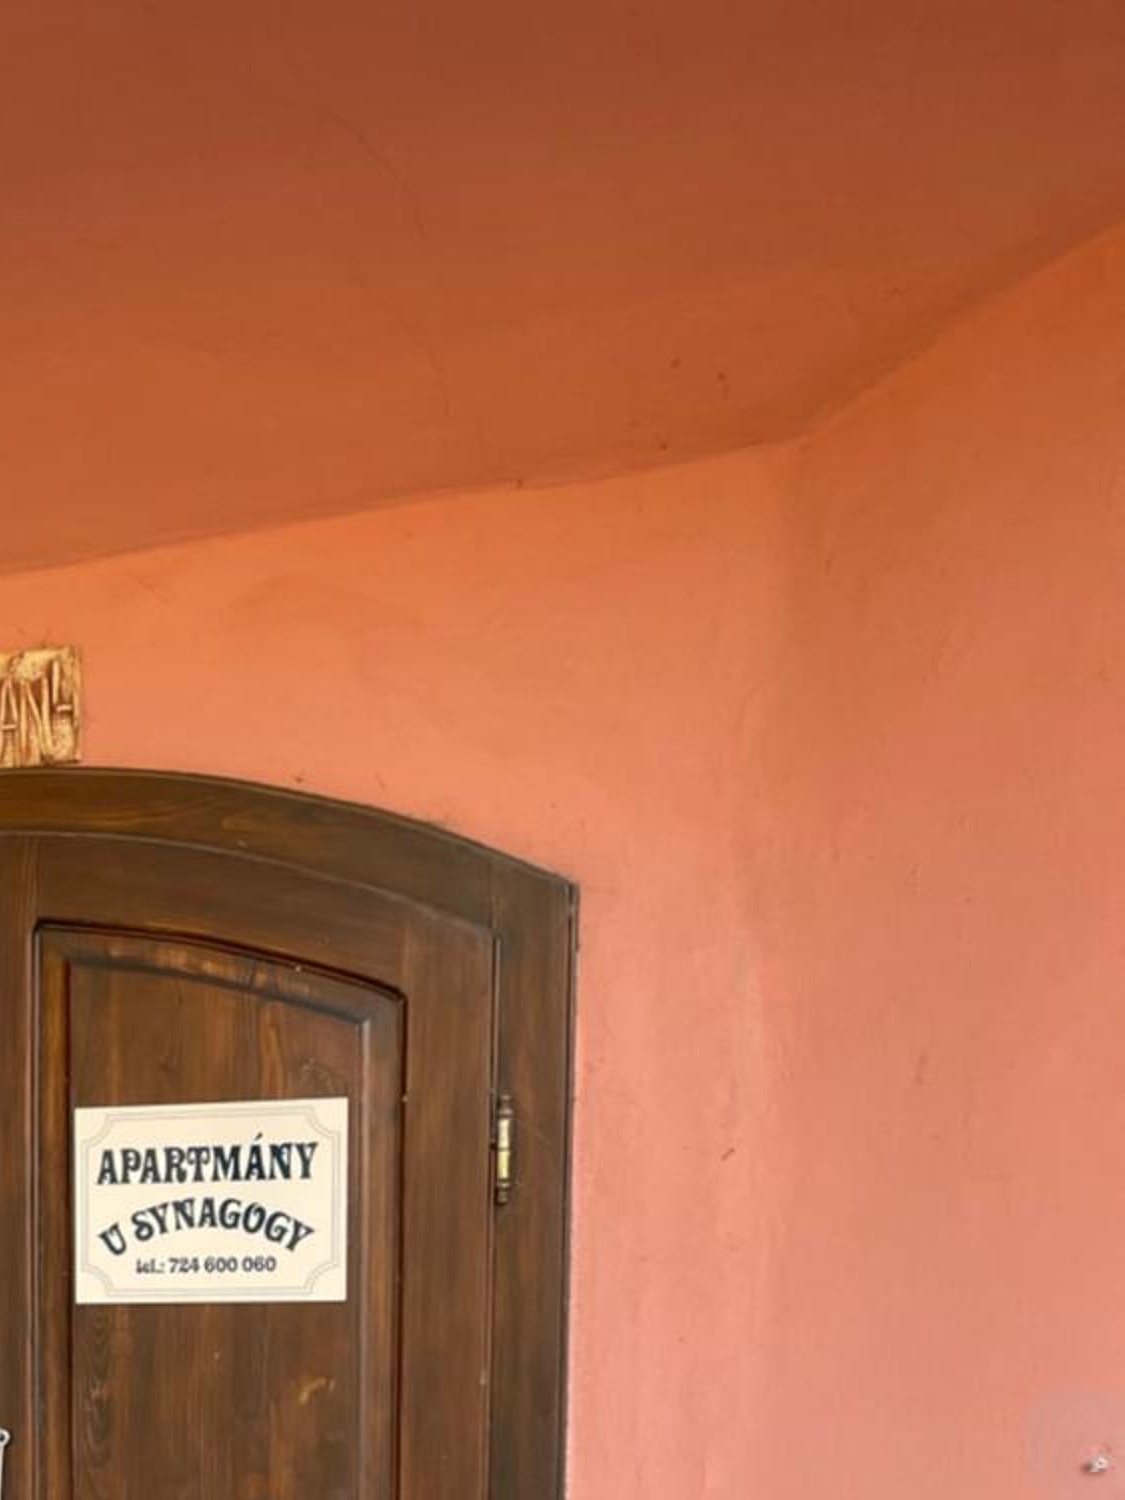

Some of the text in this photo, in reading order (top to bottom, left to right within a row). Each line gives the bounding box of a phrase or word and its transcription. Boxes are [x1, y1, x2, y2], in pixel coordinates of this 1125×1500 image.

[97, 1132, 318, 1185] APARTMÁNY
[98, 1198, 315, 1256] U SYNAGOGY
[169, 1257, 200, 1274] 724
[204, 1256, 238, 1274] 600
[242, 1255, 277, 1273] 060
